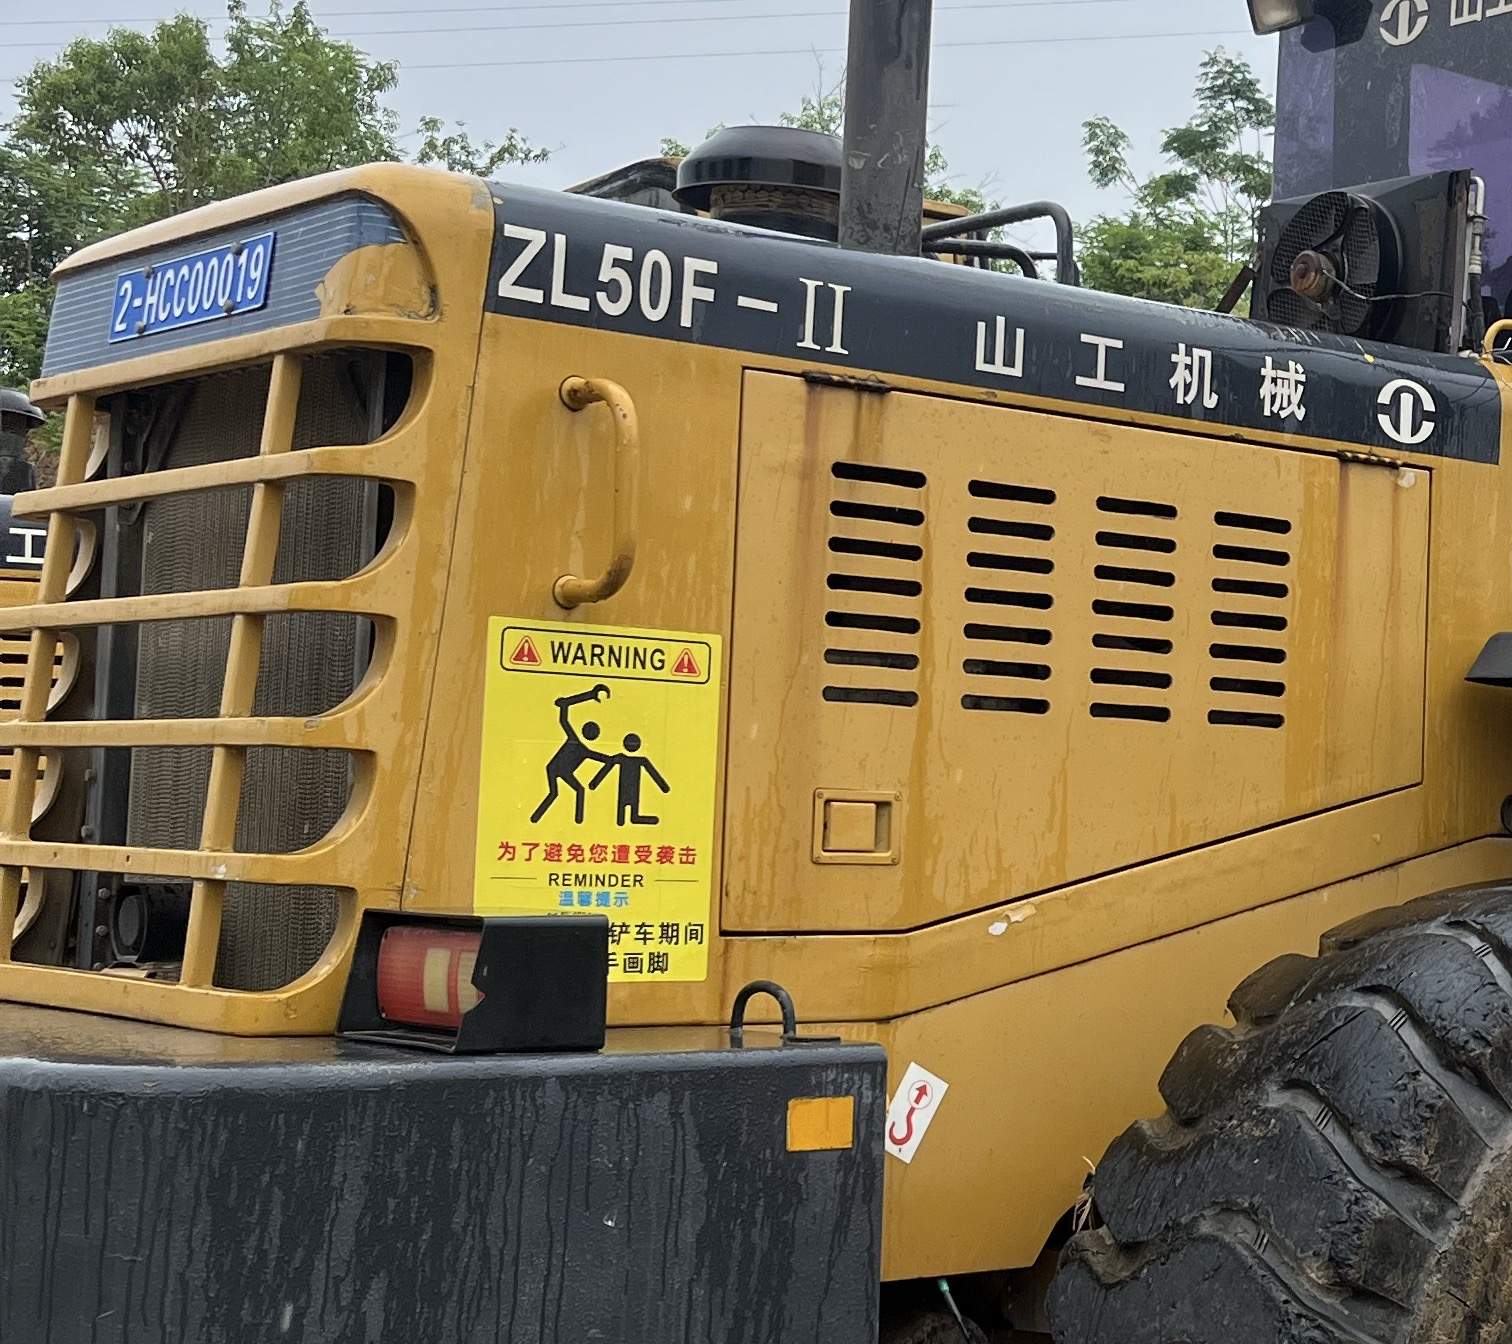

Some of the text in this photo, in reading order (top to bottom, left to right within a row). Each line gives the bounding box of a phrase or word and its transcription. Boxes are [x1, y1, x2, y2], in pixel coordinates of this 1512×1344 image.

[114, 244, 264, 333] 2-HCC00019
[975, 315, 1306, 421] 山工机械
[550, 640, 666, 671] WARNING
[497, 841, 697, 865] 为了避免您遭受袭击
[548, 873, 644, 887] REMINDER
[559, 891, 629, 907] 温馨提示
